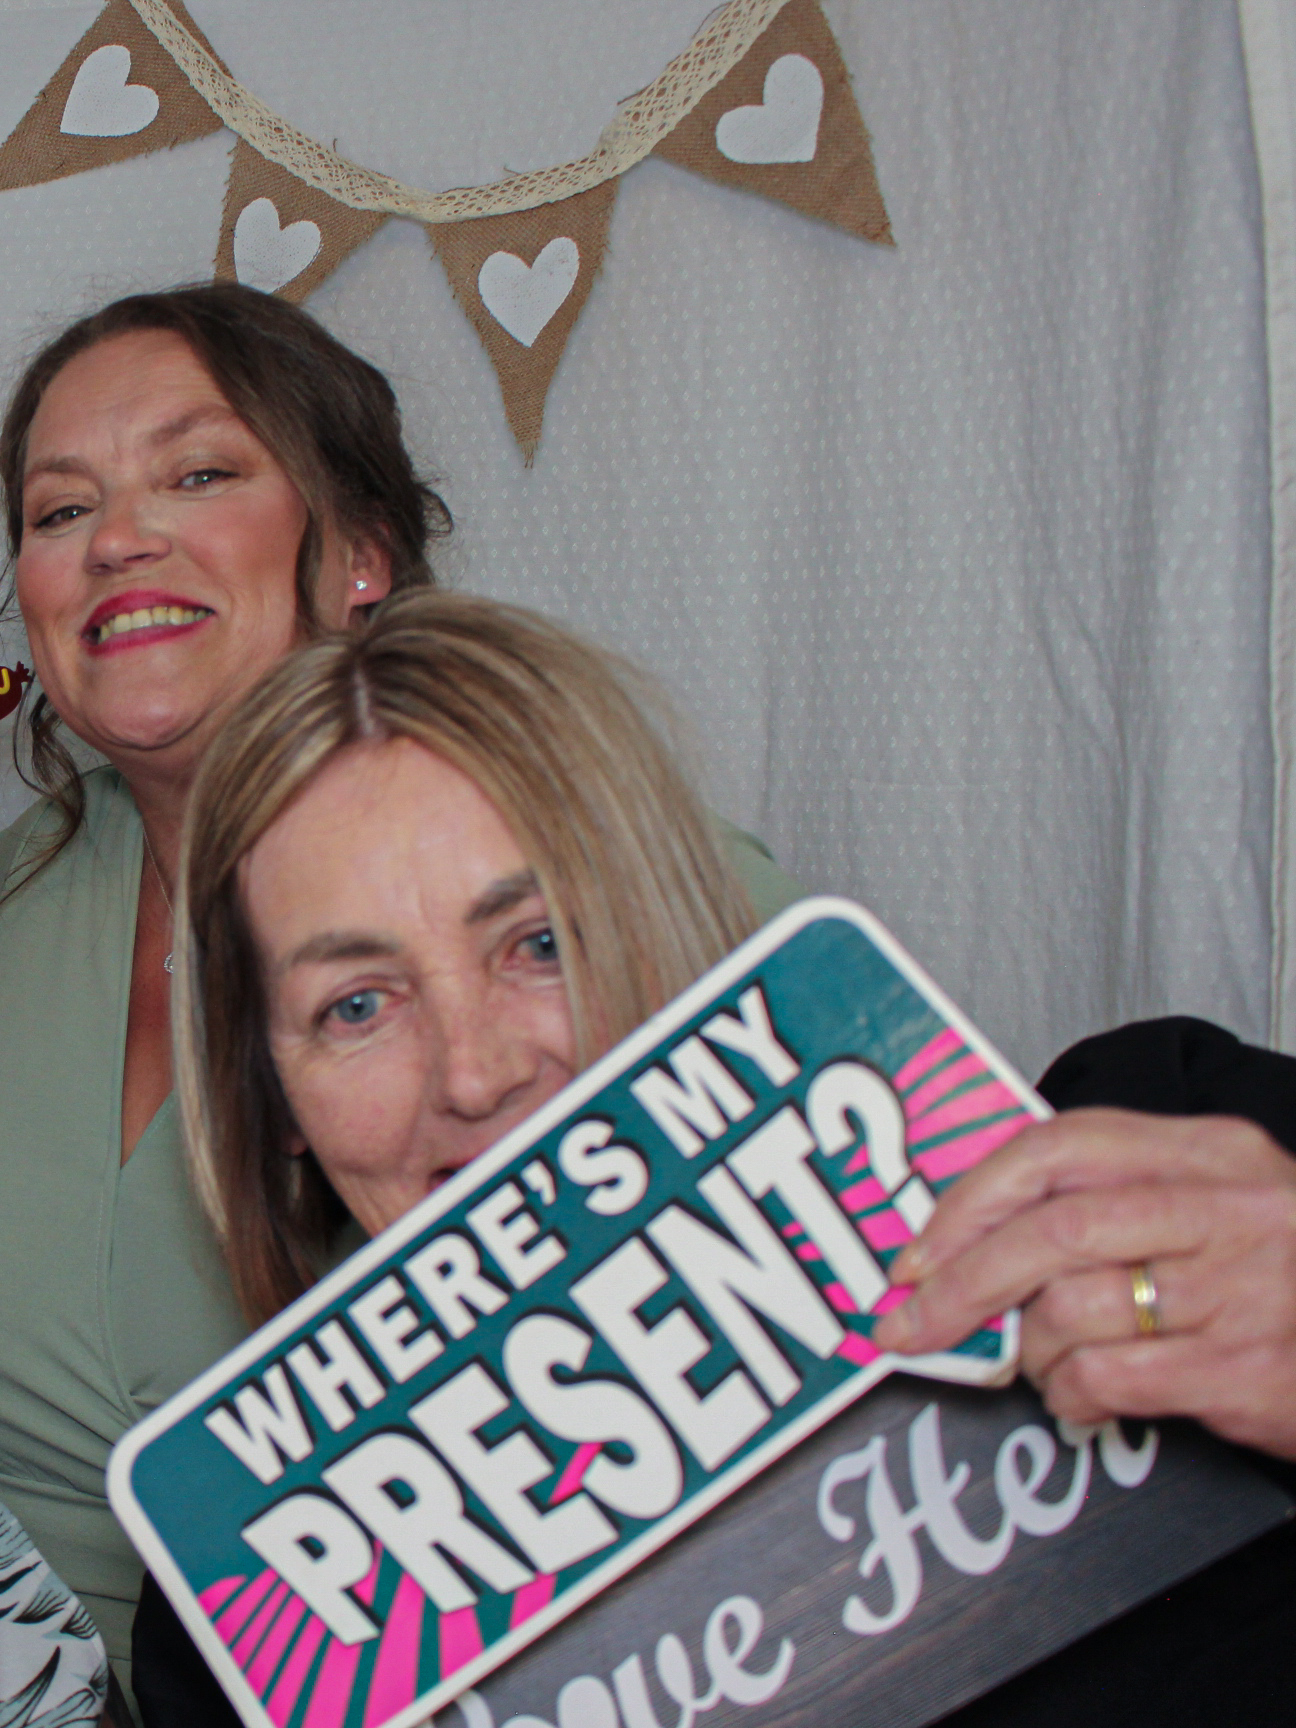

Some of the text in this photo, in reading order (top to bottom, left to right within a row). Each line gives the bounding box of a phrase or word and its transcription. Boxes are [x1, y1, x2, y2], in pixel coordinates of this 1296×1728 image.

[205, 987, 801, 1485] WHERE'S MY
[240, 1060, 937, 1646] PRESENT?
[452, 1595, 796, 1728] ove
